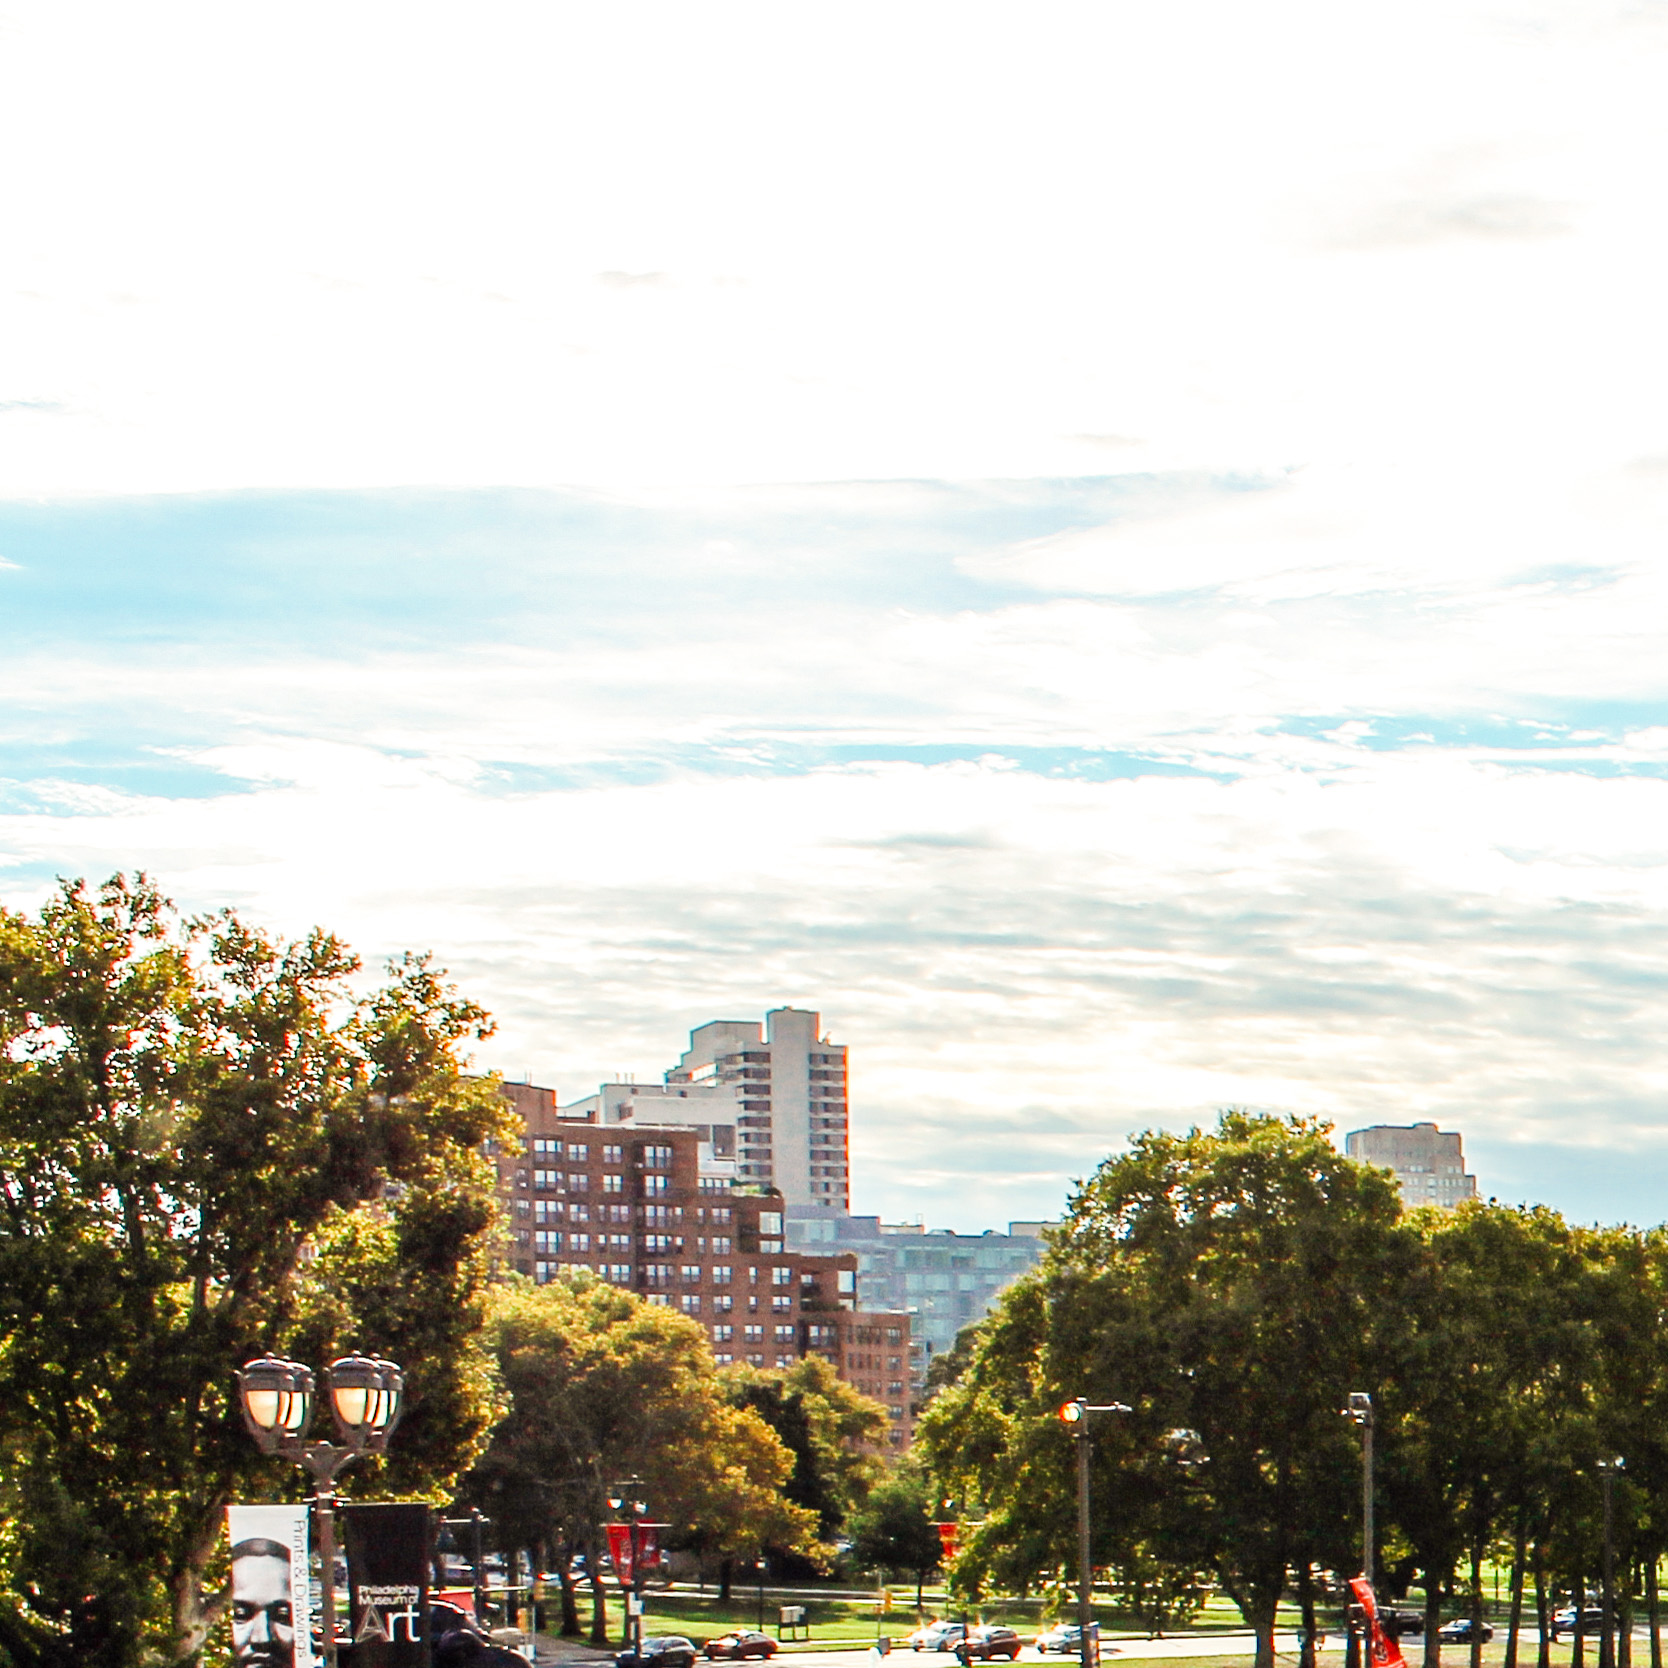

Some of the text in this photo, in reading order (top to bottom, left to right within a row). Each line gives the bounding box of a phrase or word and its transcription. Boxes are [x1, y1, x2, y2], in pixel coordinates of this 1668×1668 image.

[293, 1520, 307, 1658] Prints & Drawings
[358, 1585, 420, 1597] Philadelphia
[358, 1594, 420, 1605] Museum of
[355, 1603, 421, 1643] Art
